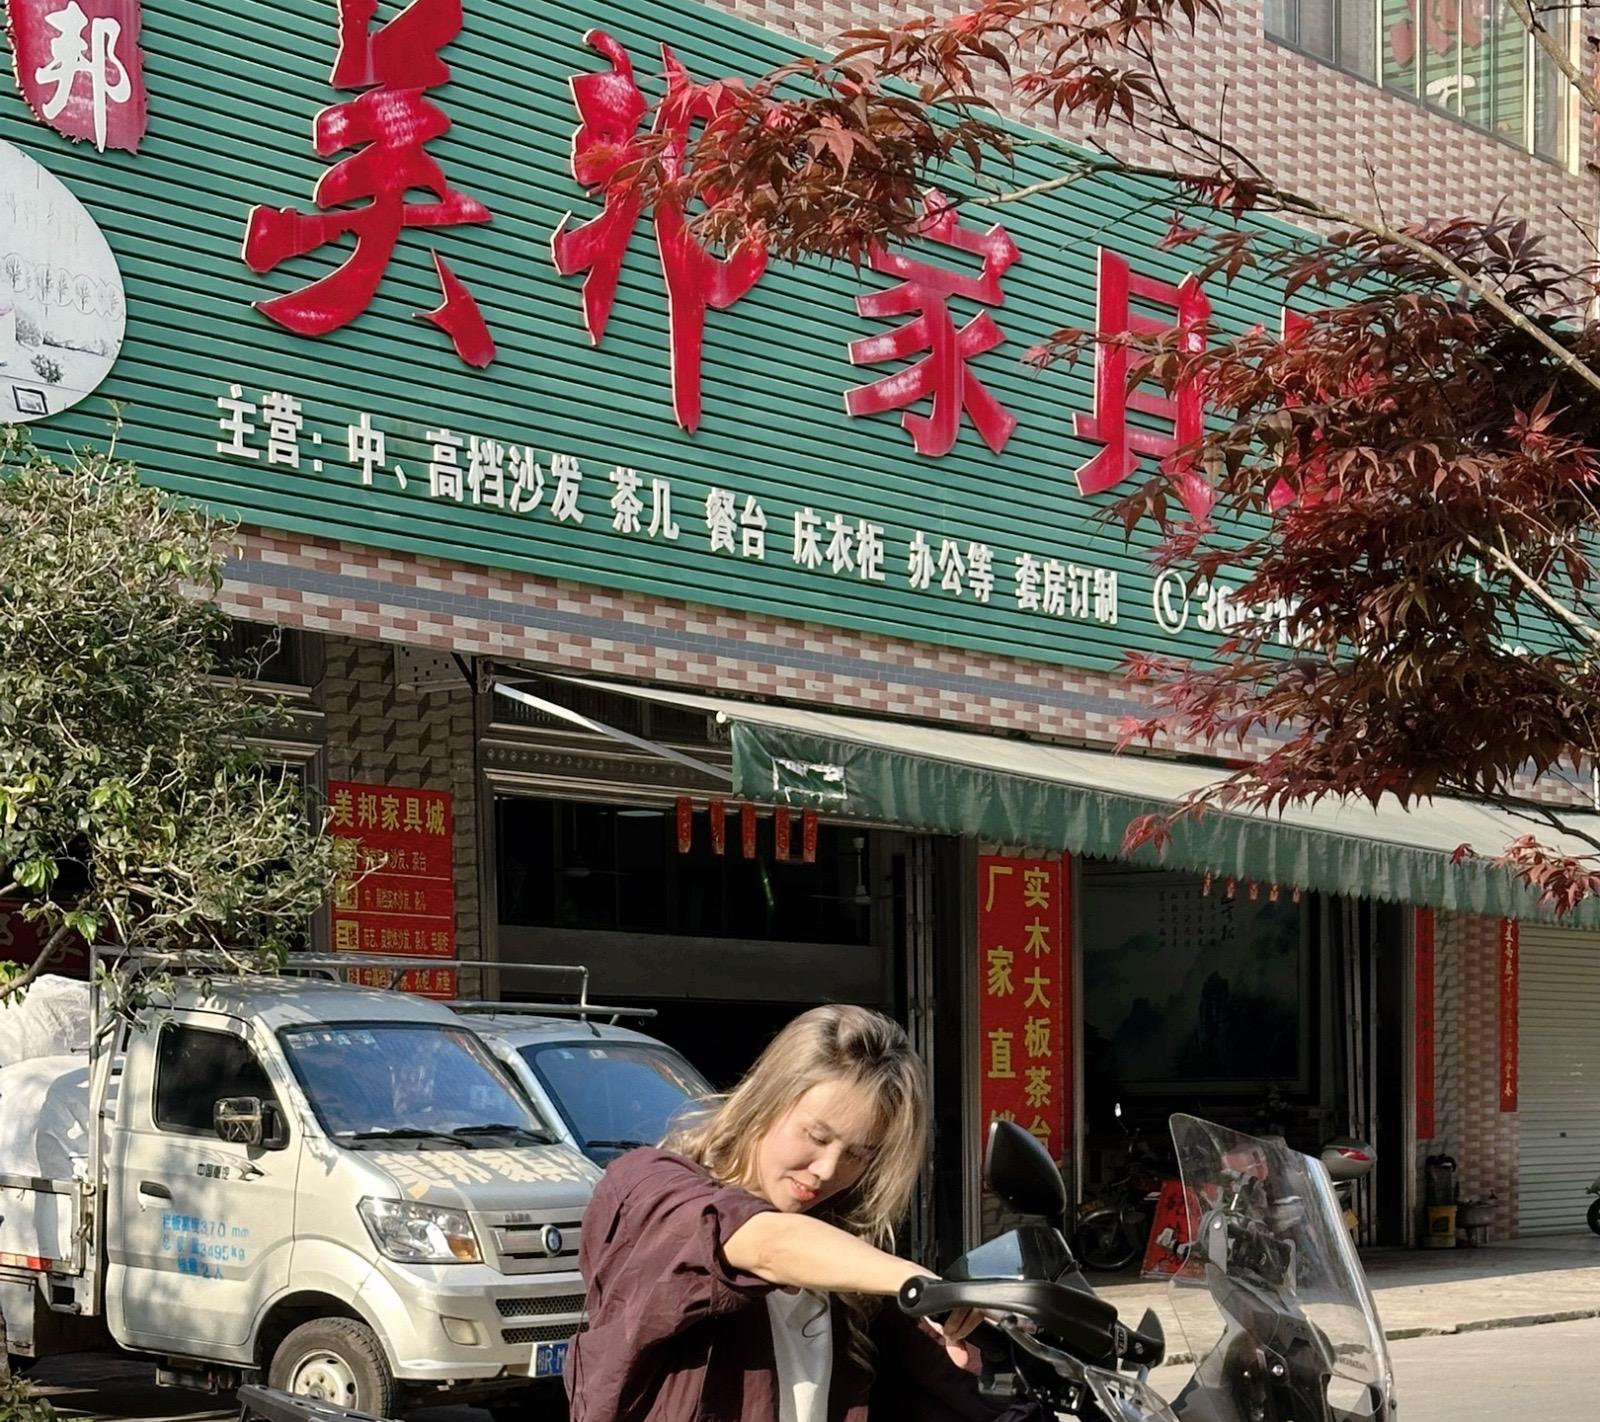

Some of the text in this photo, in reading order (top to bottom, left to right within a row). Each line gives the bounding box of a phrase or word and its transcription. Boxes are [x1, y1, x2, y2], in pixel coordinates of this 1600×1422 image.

[35, 1, 131, 152] 邦
[609, 466, 680, 540] 茶几
[705, 487, 767, 560] 餐台
[793, 507, 886, 581] 床衣柜
[908, 530, 995, 603] 办公等
[1015, 552, 1118, 625] 套房订制
[335, 789, 446, 836] 美邦家具城
[985, 865, 1017, 1124] 厂家直
